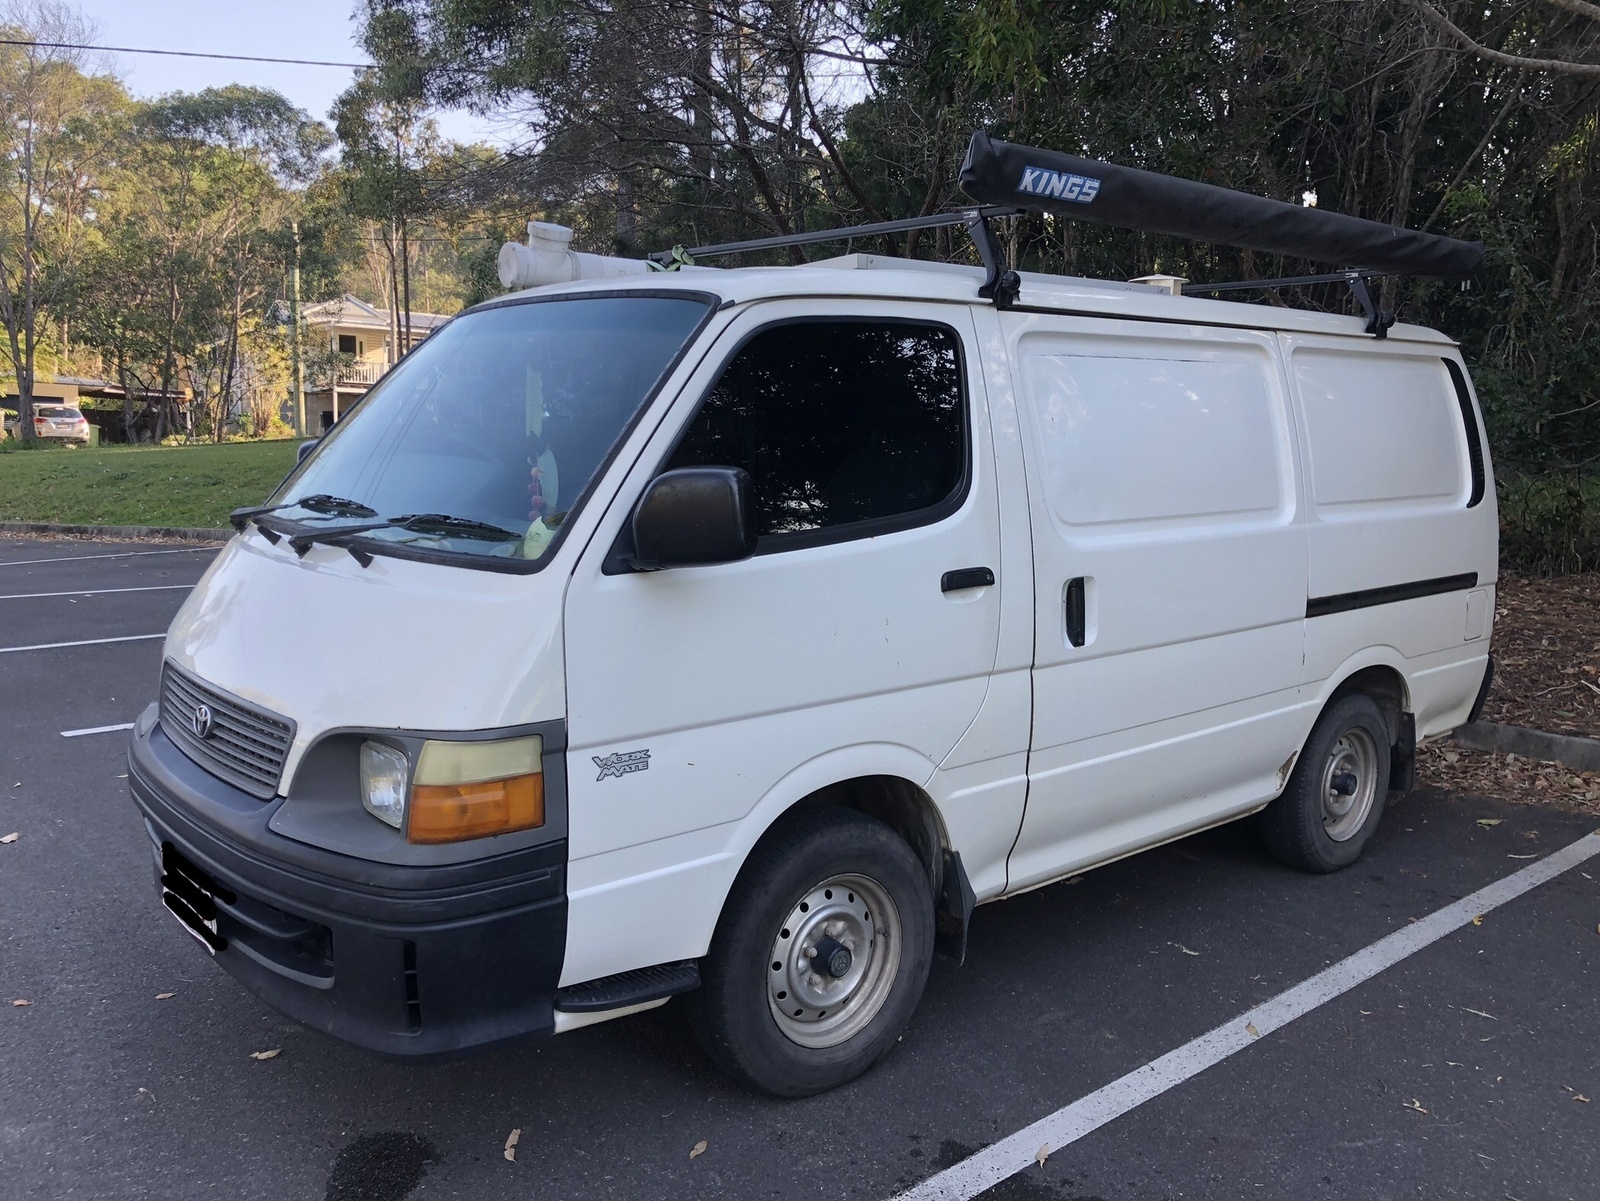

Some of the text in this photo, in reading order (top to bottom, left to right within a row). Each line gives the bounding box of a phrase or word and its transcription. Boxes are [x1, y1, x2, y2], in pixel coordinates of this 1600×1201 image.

[1019, 168, 1099, 202] KINGS
[591, 749, 651, 768] WORK
[596, 760, 648, 782] MATE
